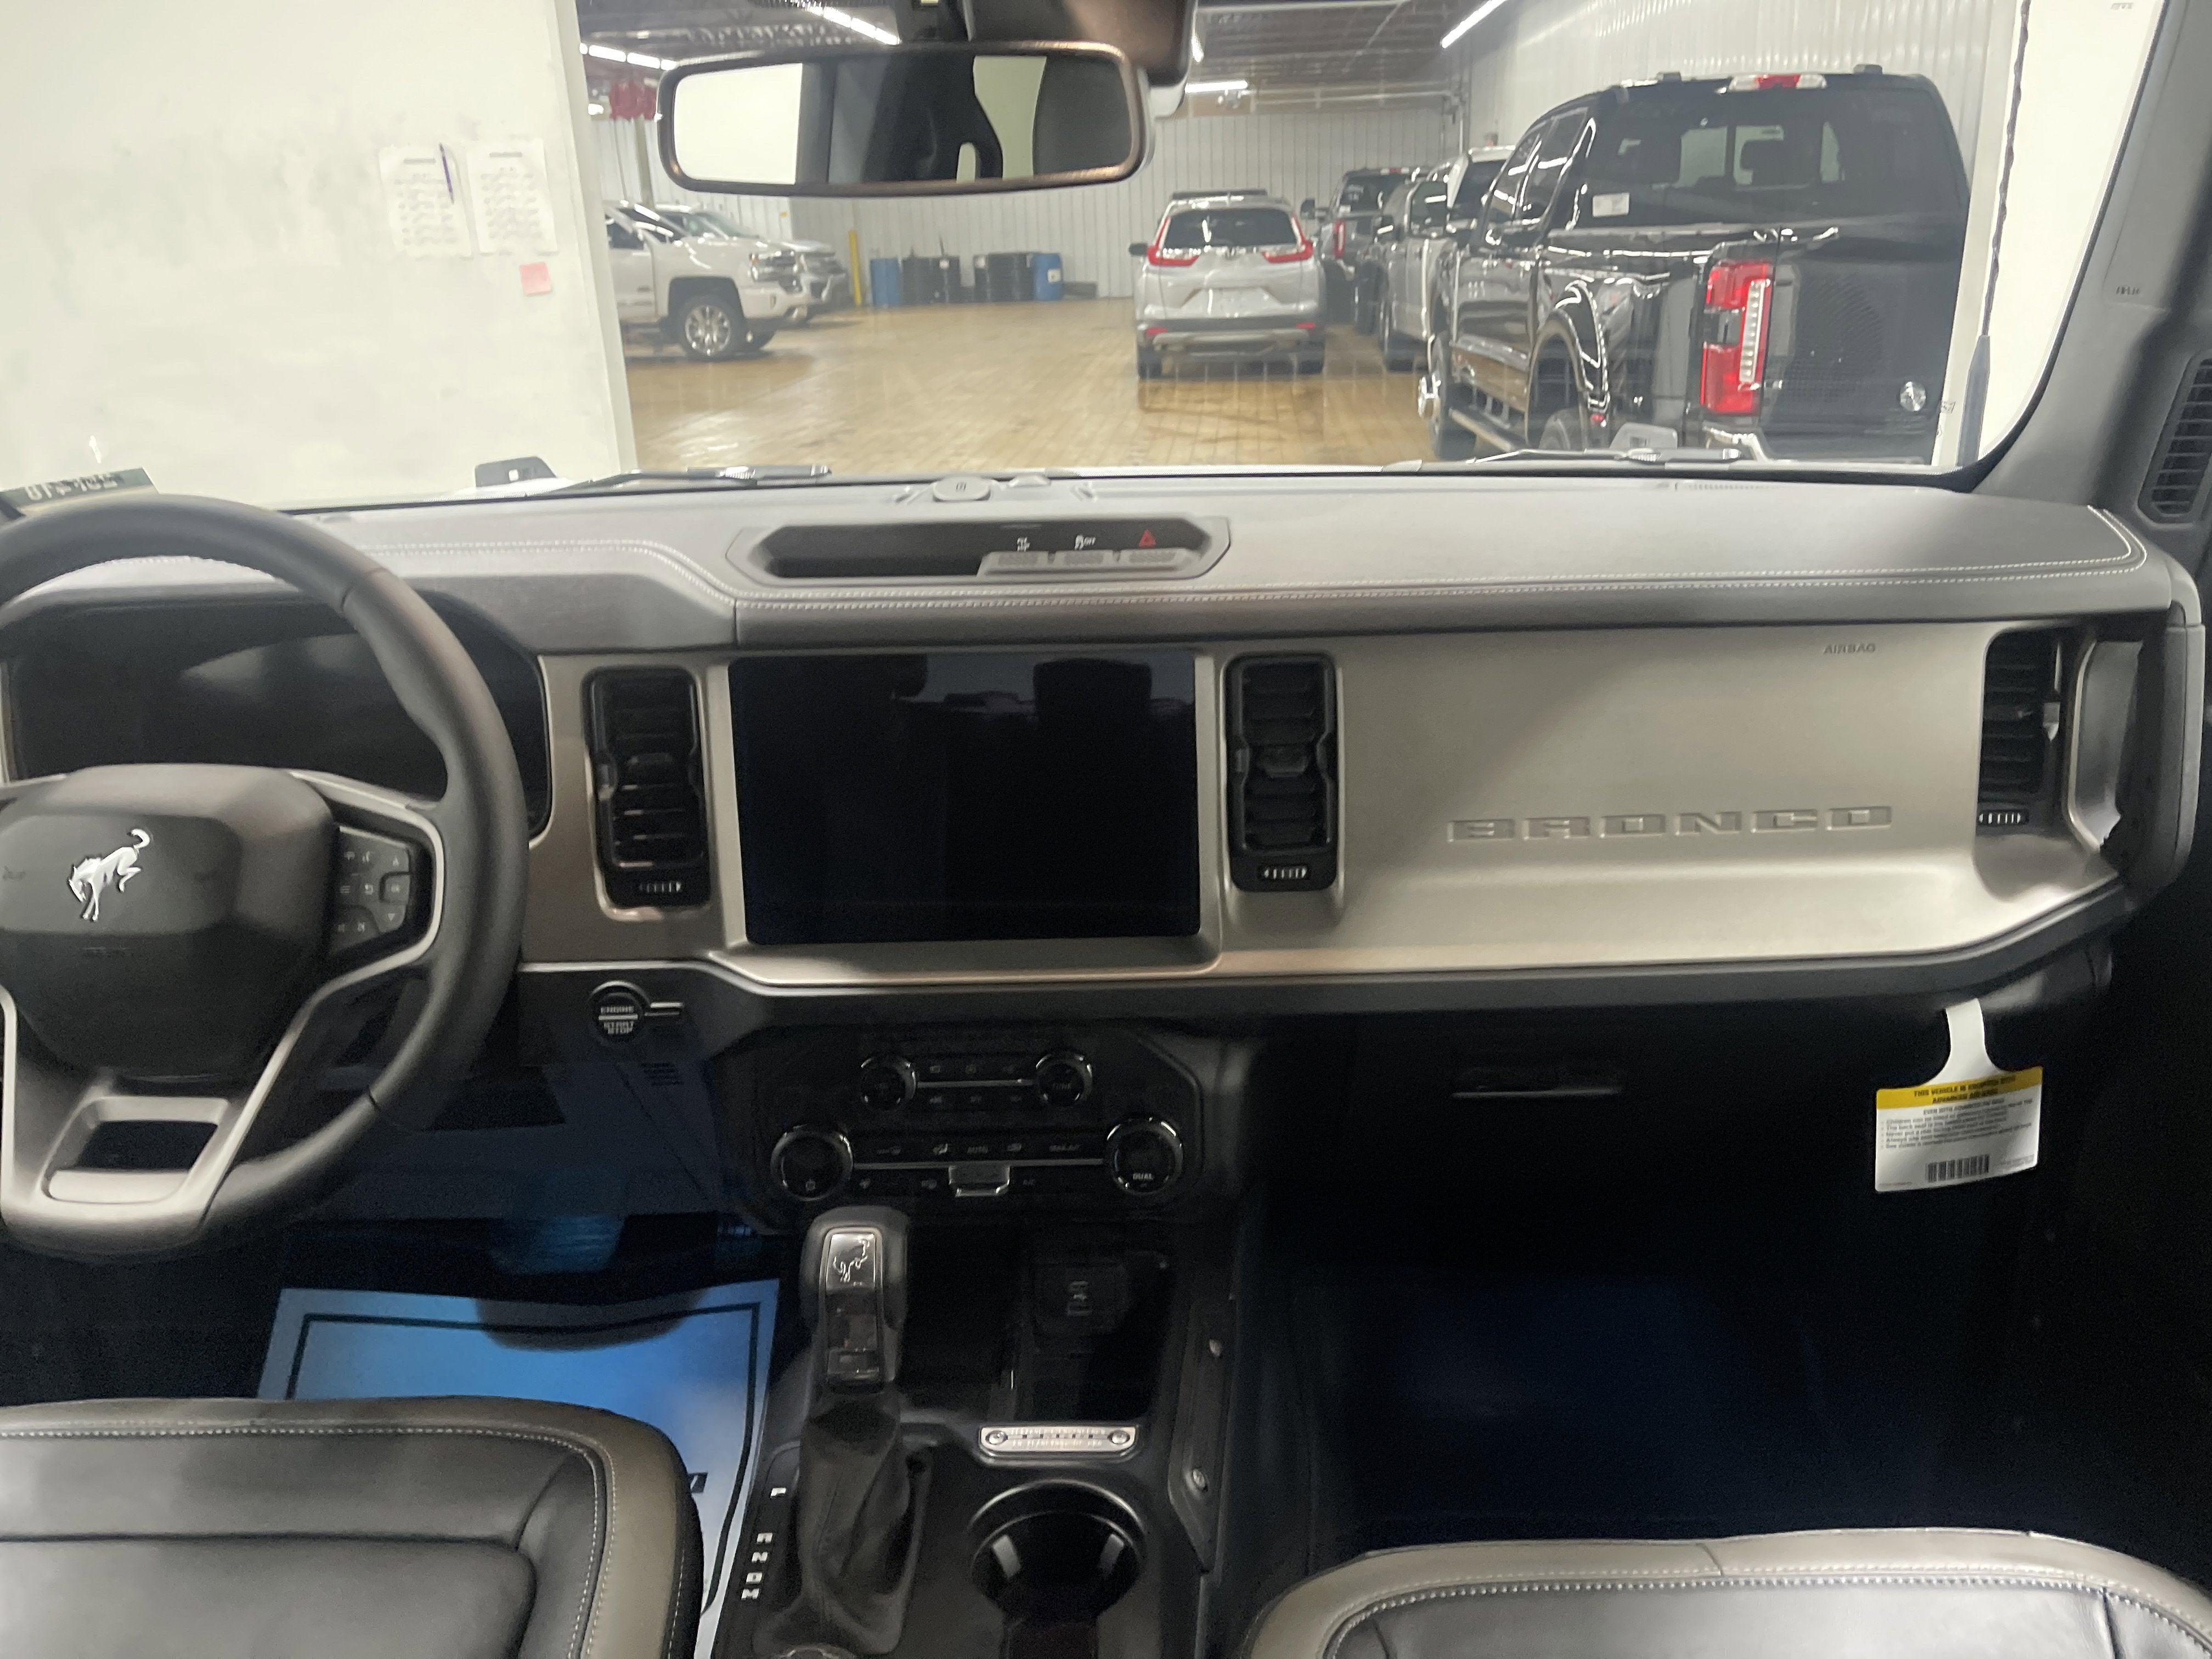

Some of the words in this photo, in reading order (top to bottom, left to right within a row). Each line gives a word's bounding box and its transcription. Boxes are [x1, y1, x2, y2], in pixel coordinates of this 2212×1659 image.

[1823, 642, 1875, 654] AIRBAG
[1446, 805, 1893, 844] BRONCO
[1132, 1172, 1154, 1181] DUAL
[770, 1487, 786, 1499] P
[756, 1532, 773, 1545] R
[751, 1551, 768, 1563] N
[746, 1572, 763, 1584] D
[741, 1588, 760, 1601] M
